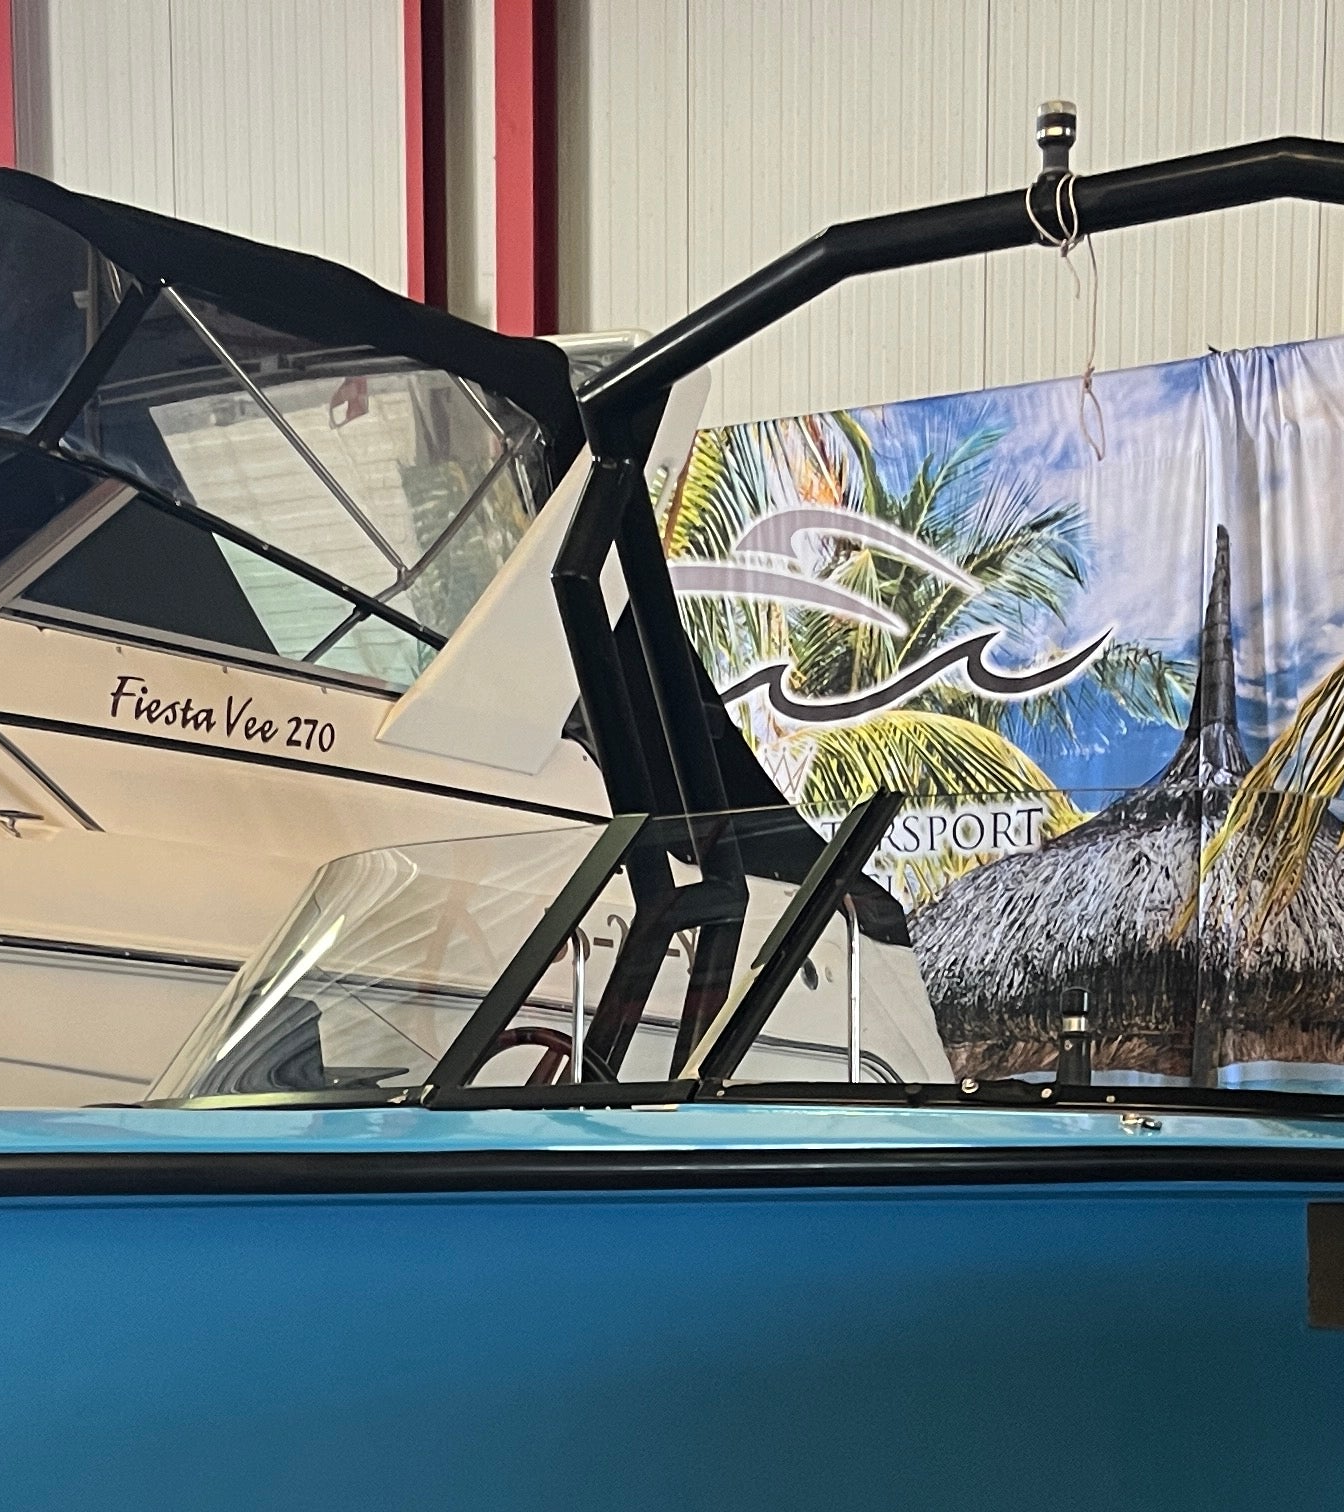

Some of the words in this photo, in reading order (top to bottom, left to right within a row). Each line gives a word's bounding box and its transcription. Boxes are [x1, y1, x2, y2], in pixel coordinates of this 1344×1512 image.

[110, 676, 216, 733] Fiesta
[224, 695, 278, 743] Vee
[286, 716, 335, 752] 270
